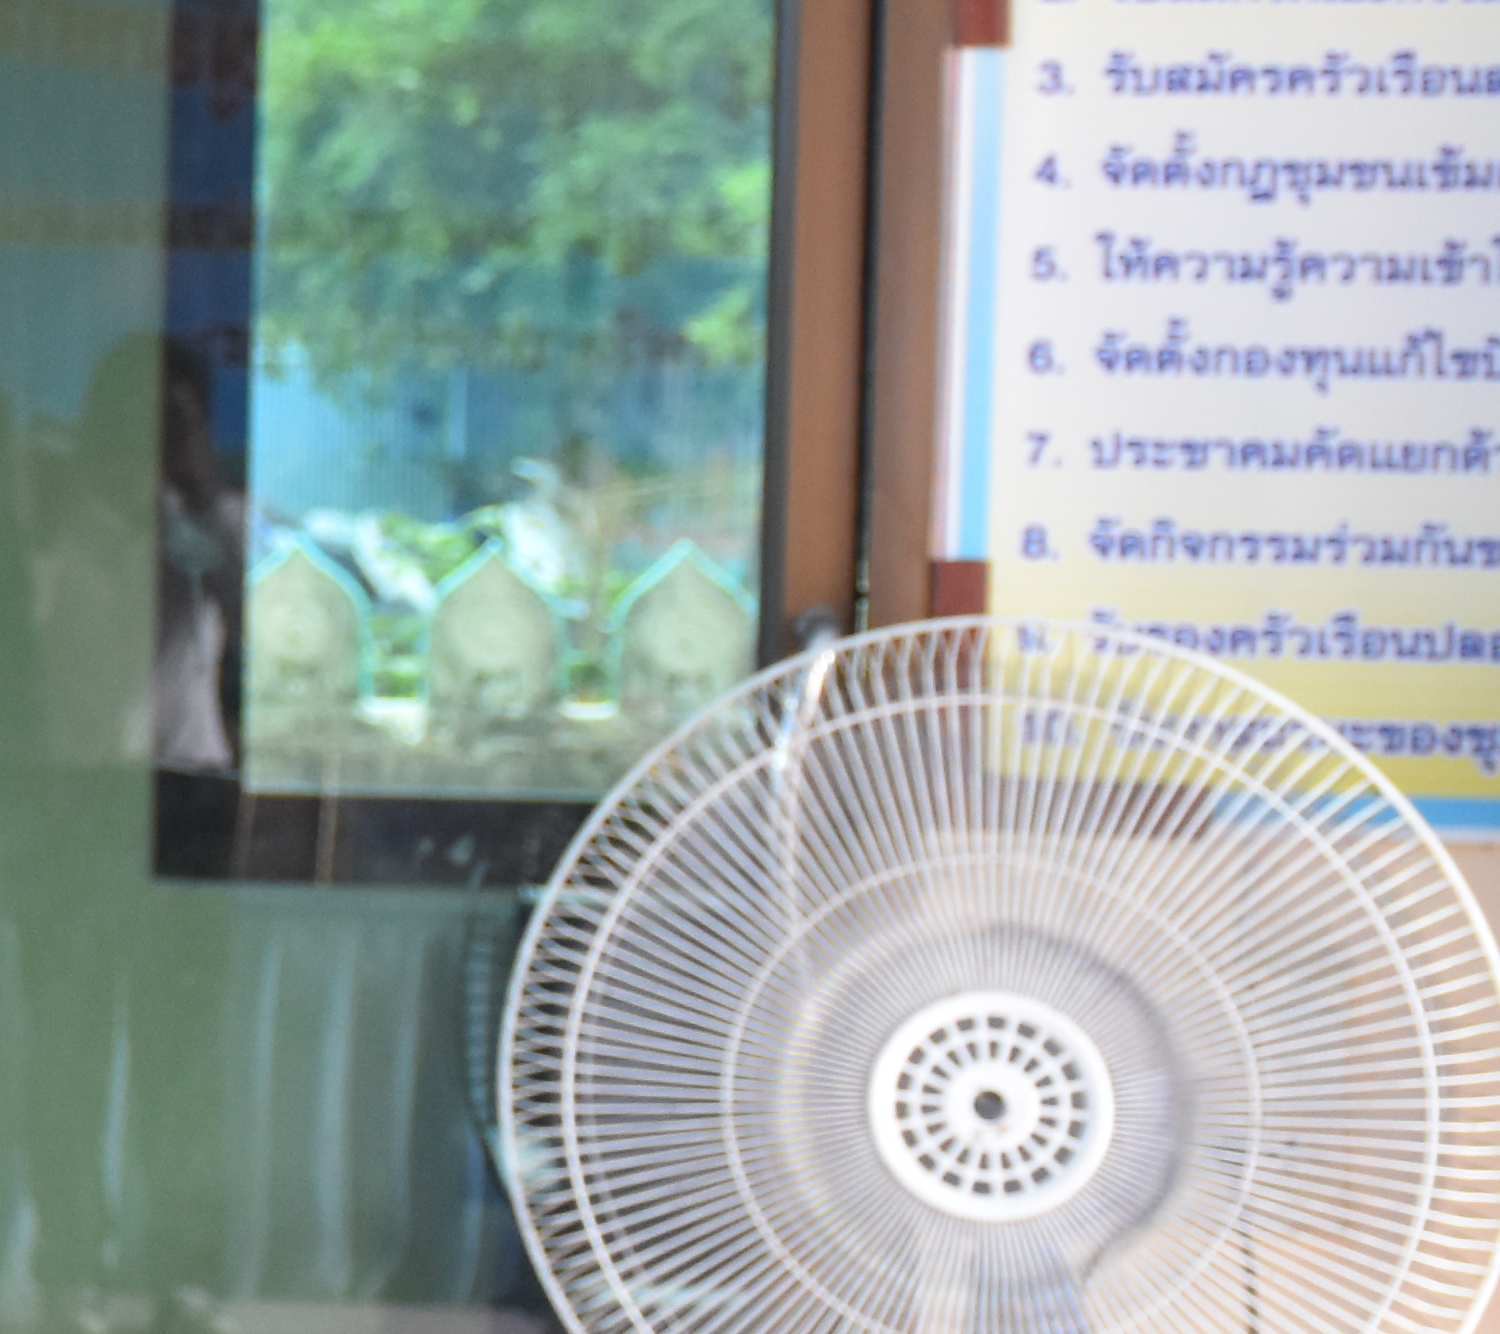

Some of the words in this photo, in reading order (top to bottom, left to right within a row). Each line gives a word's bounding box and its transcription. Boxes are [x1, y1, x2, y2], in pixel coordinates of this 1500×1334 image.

[1037, 58, 1073, 96] 3.
[1034, 154, 1070, 187] 4.
[1101, 130, 1500, 208] จัดตั้งกฎชุมชนเข้ม
[1031, 244, 1067, 282] 5.
[1026, 340, 1063, 375] 6.
[1026, 430, 1060, 467] 7.
[1091, 425, 1500, 476] ประชาคมคัดแยกค้
[1020, 524, 1057, 561] 8.
